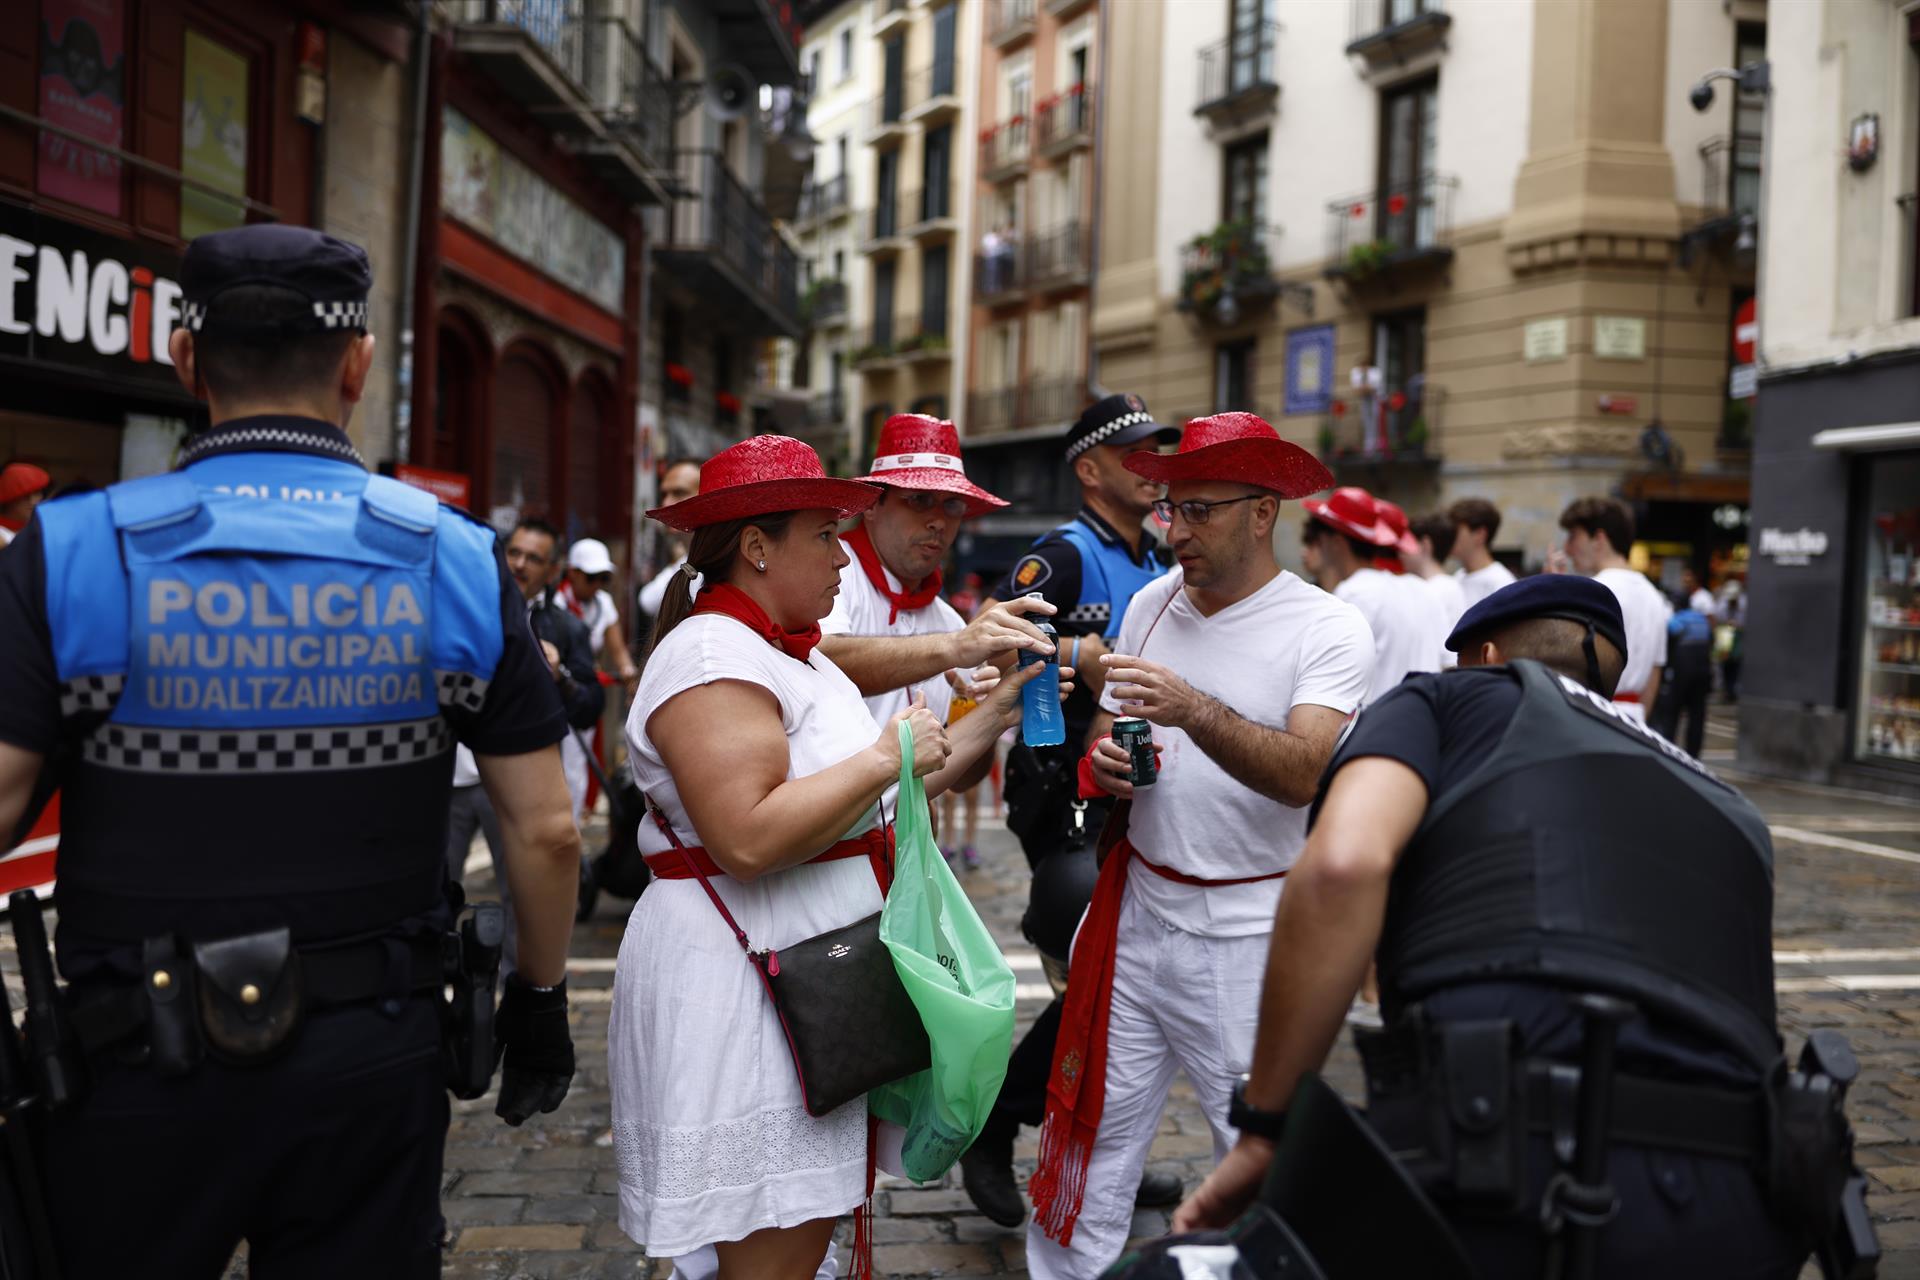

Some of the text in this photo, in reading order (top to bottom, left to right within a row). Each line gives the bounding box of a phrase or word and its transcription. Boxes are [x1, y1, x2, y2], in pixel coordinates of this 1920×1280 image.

[148, 579, 424, 627] POLICIA
[149, 632, 423, 668] MUNICIPAL
[147, 672, 423, 711] UDALTZAINGOA
